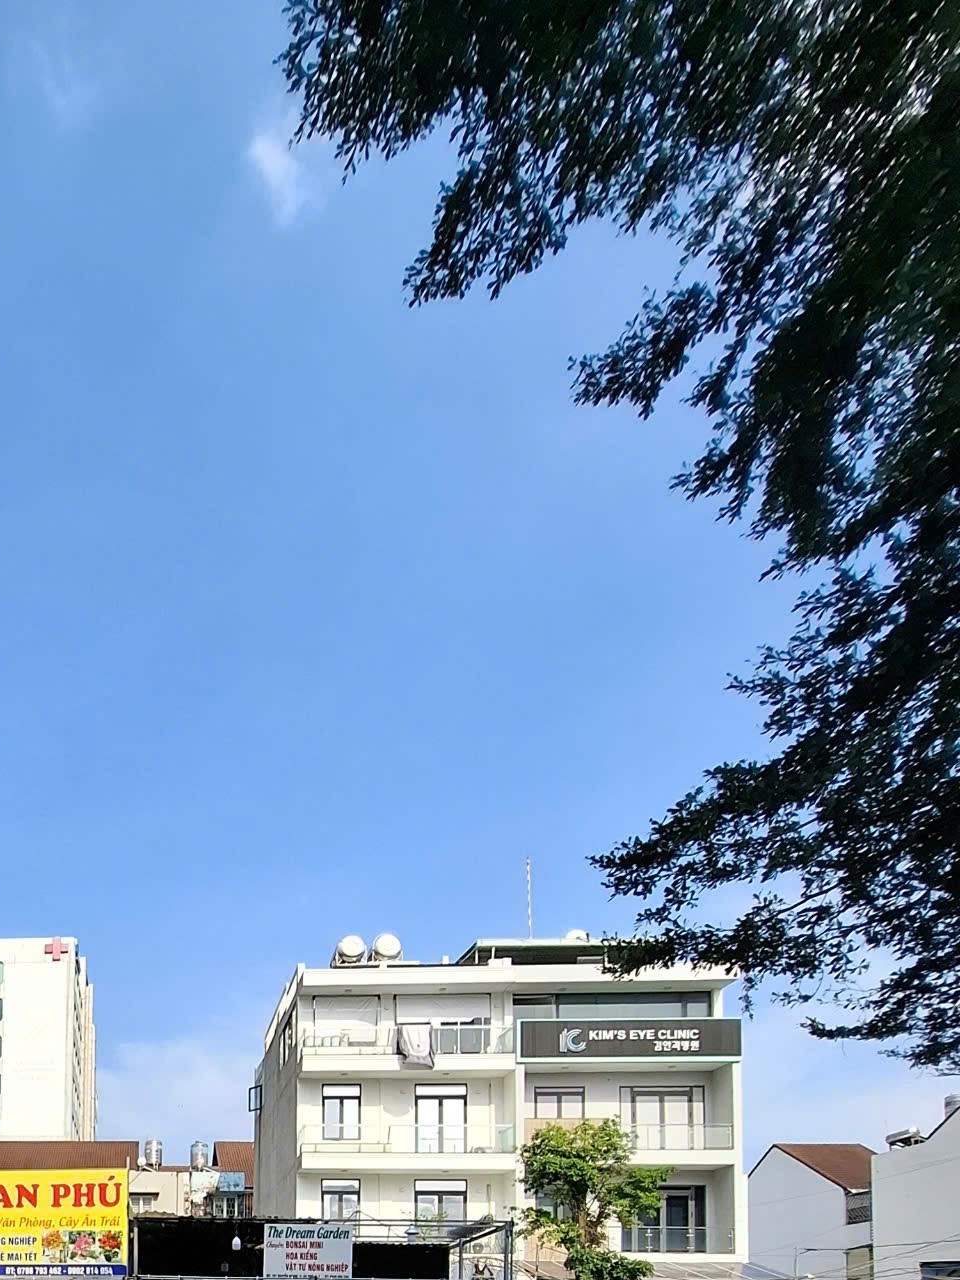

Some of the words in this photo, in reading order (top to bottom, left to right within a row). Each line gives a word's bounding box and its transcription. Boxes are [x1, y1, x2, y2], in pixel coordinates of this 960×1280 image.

[588, 1030, 627, 1040] KIM'S
[629, 1029, 655, 1039] EYE
[657, 1029, 700, 1040] CLINIC
[51, 1175, 122, 1207] PHÚ
[19, 1215, 55, 1229] Phòng,
[58, 1216, 79, 1229] Cây
[100, 1214, 121, 1227] Trái
[268, 1226, 284, 1239] The
[285, 1226, 315, 1239] Dream
[316, 1226, 350, 1240] Garden
[285, 1241, 308, 1249] BONSAI
[309, 1241, 324, 1249] MINI
[7, 1251, 22, 1261] MAI
[285, 1252, 298, 1260] HOA
